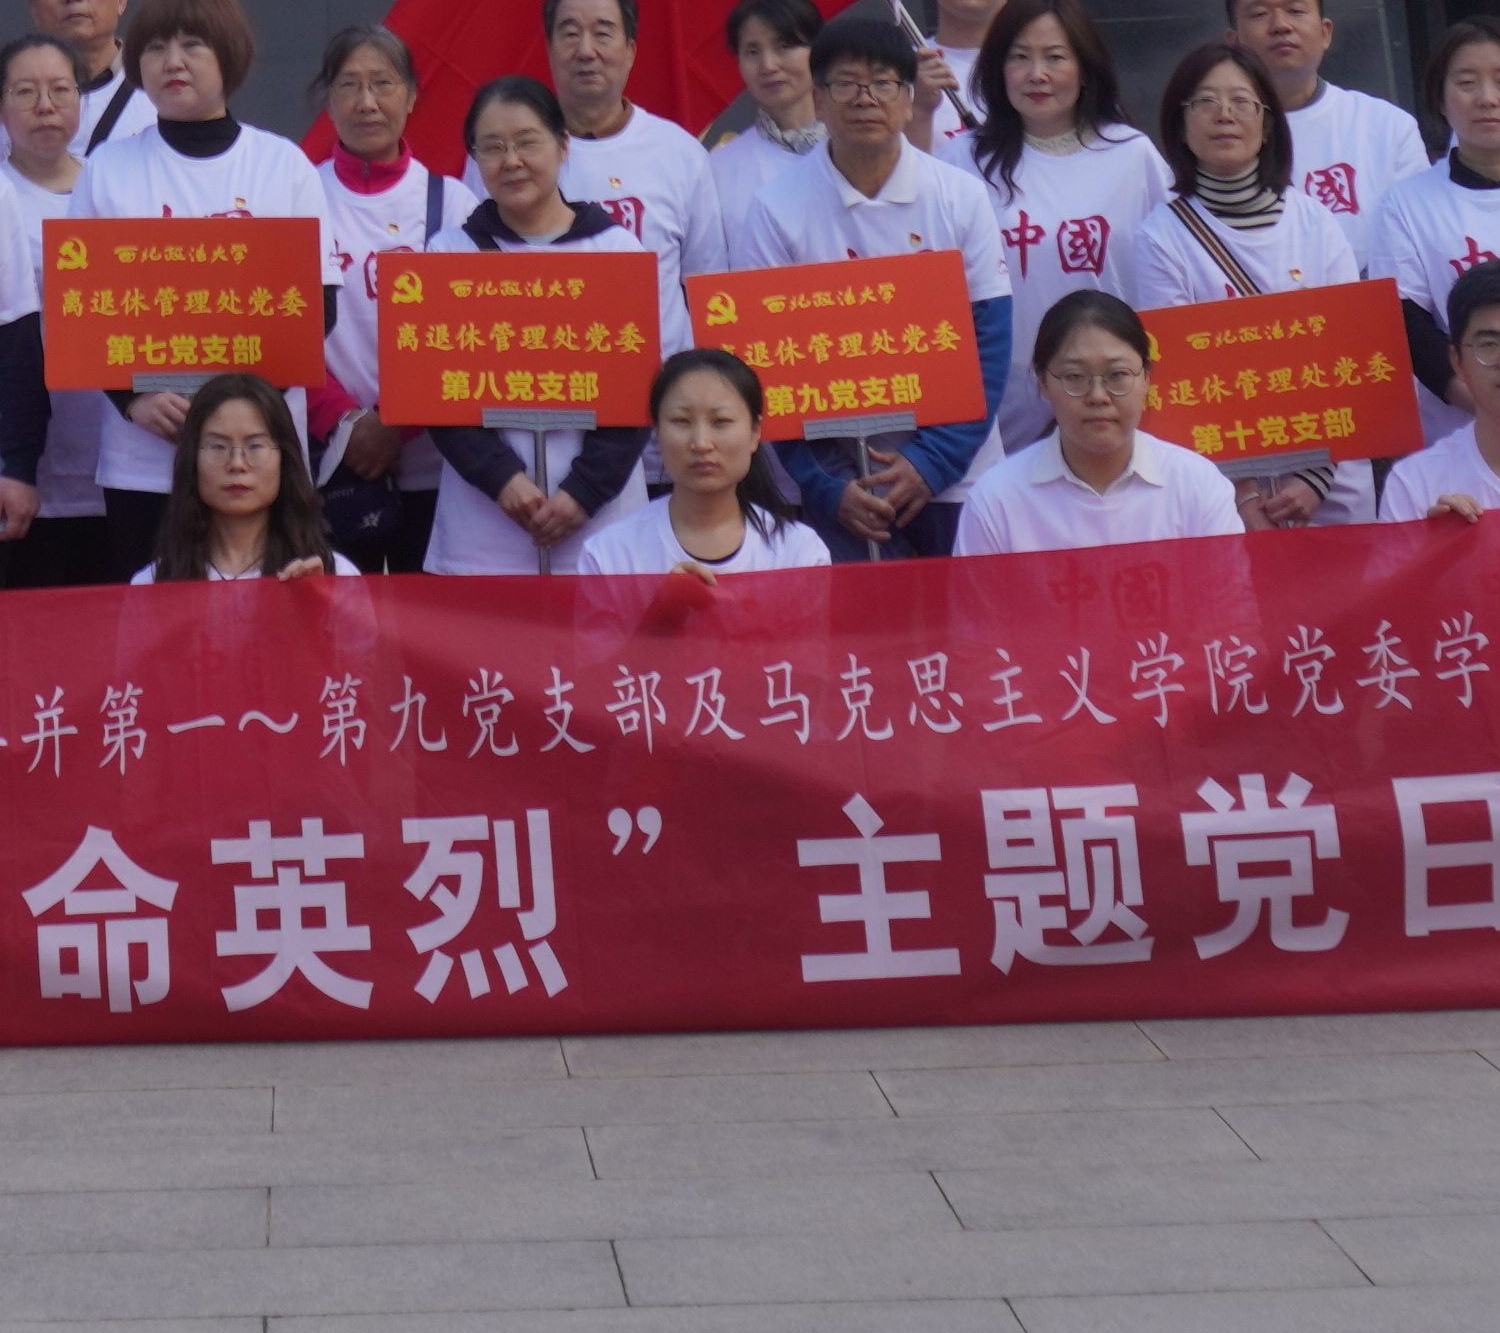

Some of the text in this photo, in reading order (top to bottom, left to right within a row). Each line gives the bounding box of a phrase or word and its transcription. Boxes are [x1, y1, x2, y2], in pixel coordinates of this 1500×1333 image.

[114, 244, 248, 265] 西北政法大学
[61, 285, 308, 318] 离退休管理处党委
[449, 278, 586, 301] 西北政法大学
[762, 282, 896, 315] 西北政法大学
[396, 322, 646, 355] 离退休管理处党委
[1186, 314, 1328, 351] 西北政法大学
[106, 334, 263, 366] 第七党支部
[441, 370, 600, 403] 第八党支部
[765, 373, 923, 417] 第九党支部
[1191, 407, 1356, 455] 第十党支部
